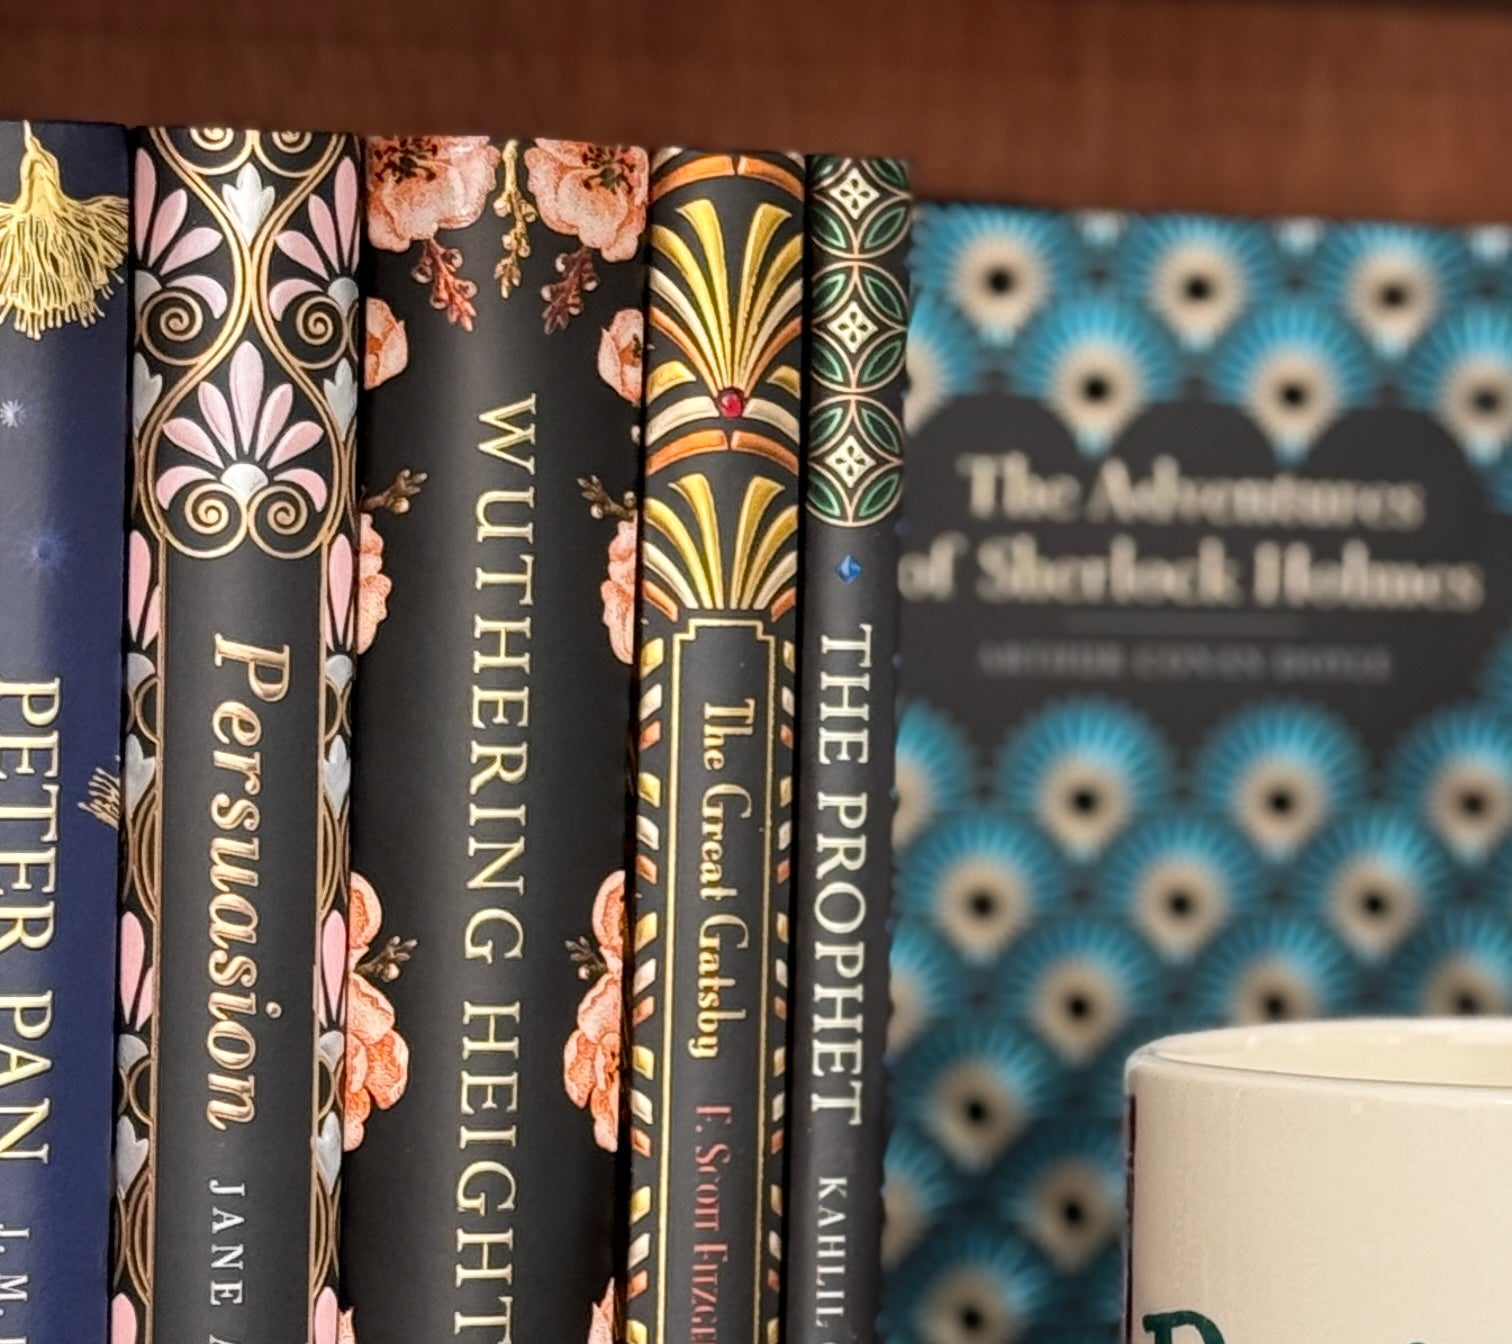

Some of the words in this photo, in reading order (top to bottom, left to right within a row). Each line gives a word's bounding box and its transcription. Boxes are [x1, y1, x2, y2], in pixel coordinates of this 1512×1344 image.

[956, 450, 1079, 523] The
[1085, 455, 1426, 531] Adventures
[898, 530, 970, 602] of
[975, 532, 1242, 607] Sherlock
[1253, 540, 1486, 613] Holmes
[462, 391, 538, 965] WUTHERING
[703, 698, 756, 771] The
[817, 623, 873, 765] THE
[0, 676, 61, 950] PETER
[205, 631, 291, 1131] Persuasion
[700, 783, 752, 901] Great
[688, 913, 750, 1058] Gatsby
[810, 791, 869, 1127] PROPHET
[0, 989, 53, 1164] PAN
[695, 1104, 732, 1134] F.
[208, 1179, 246, 1307] JANE
[815, 1176, 848, 1328] KAHLIL
